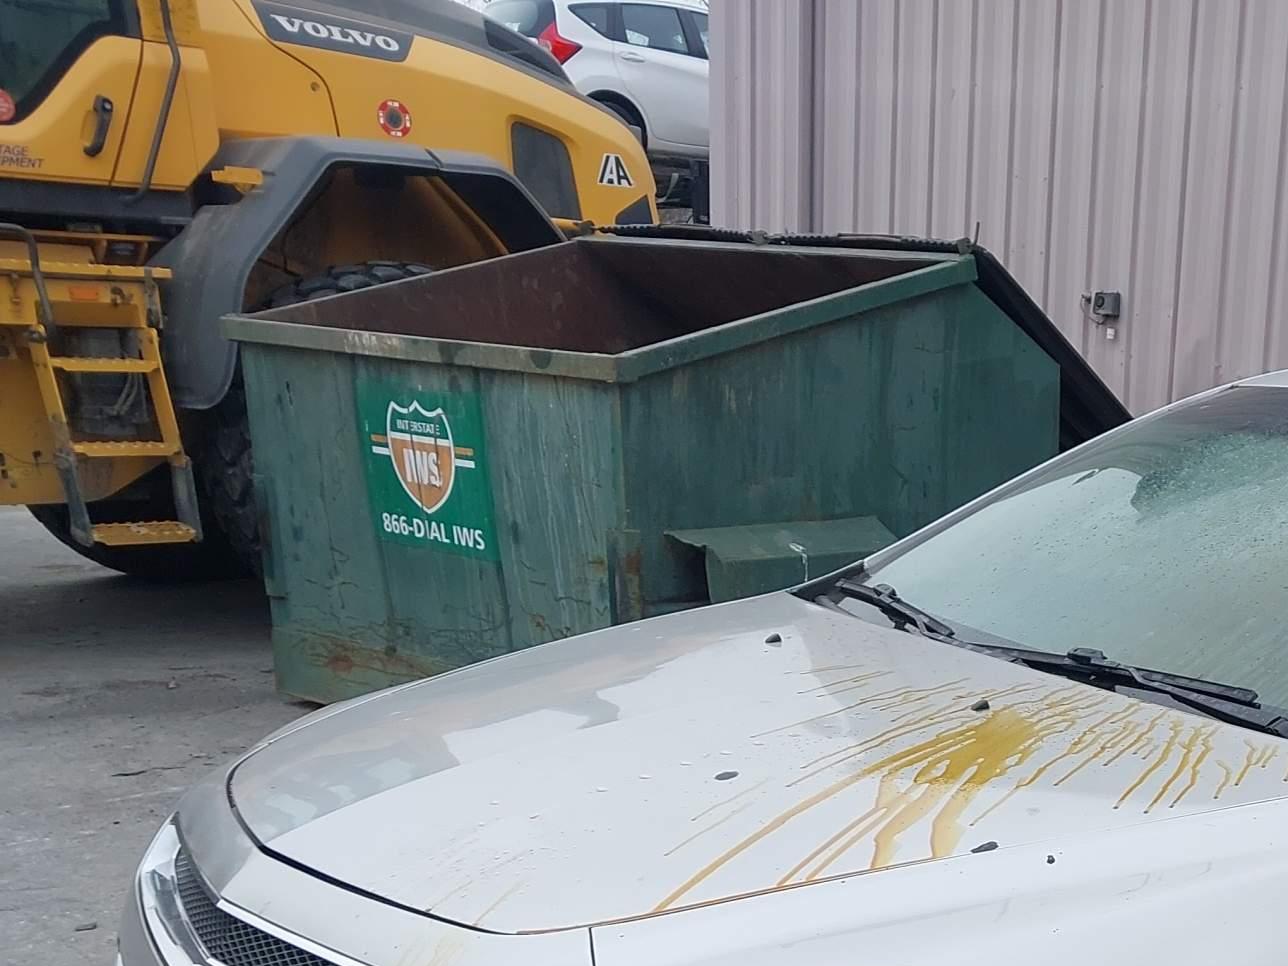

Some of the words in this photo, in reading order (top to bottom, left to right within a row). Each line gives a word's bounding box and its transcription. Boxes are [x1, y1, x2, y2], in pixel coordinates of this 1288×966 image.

[270, 14, 400, 51] VOLVO
[396, 419, 441, 436] INTERSTATE
[382, 512, 450, 543] 866-DIAL
[453, 525, 485, 550] IWS
